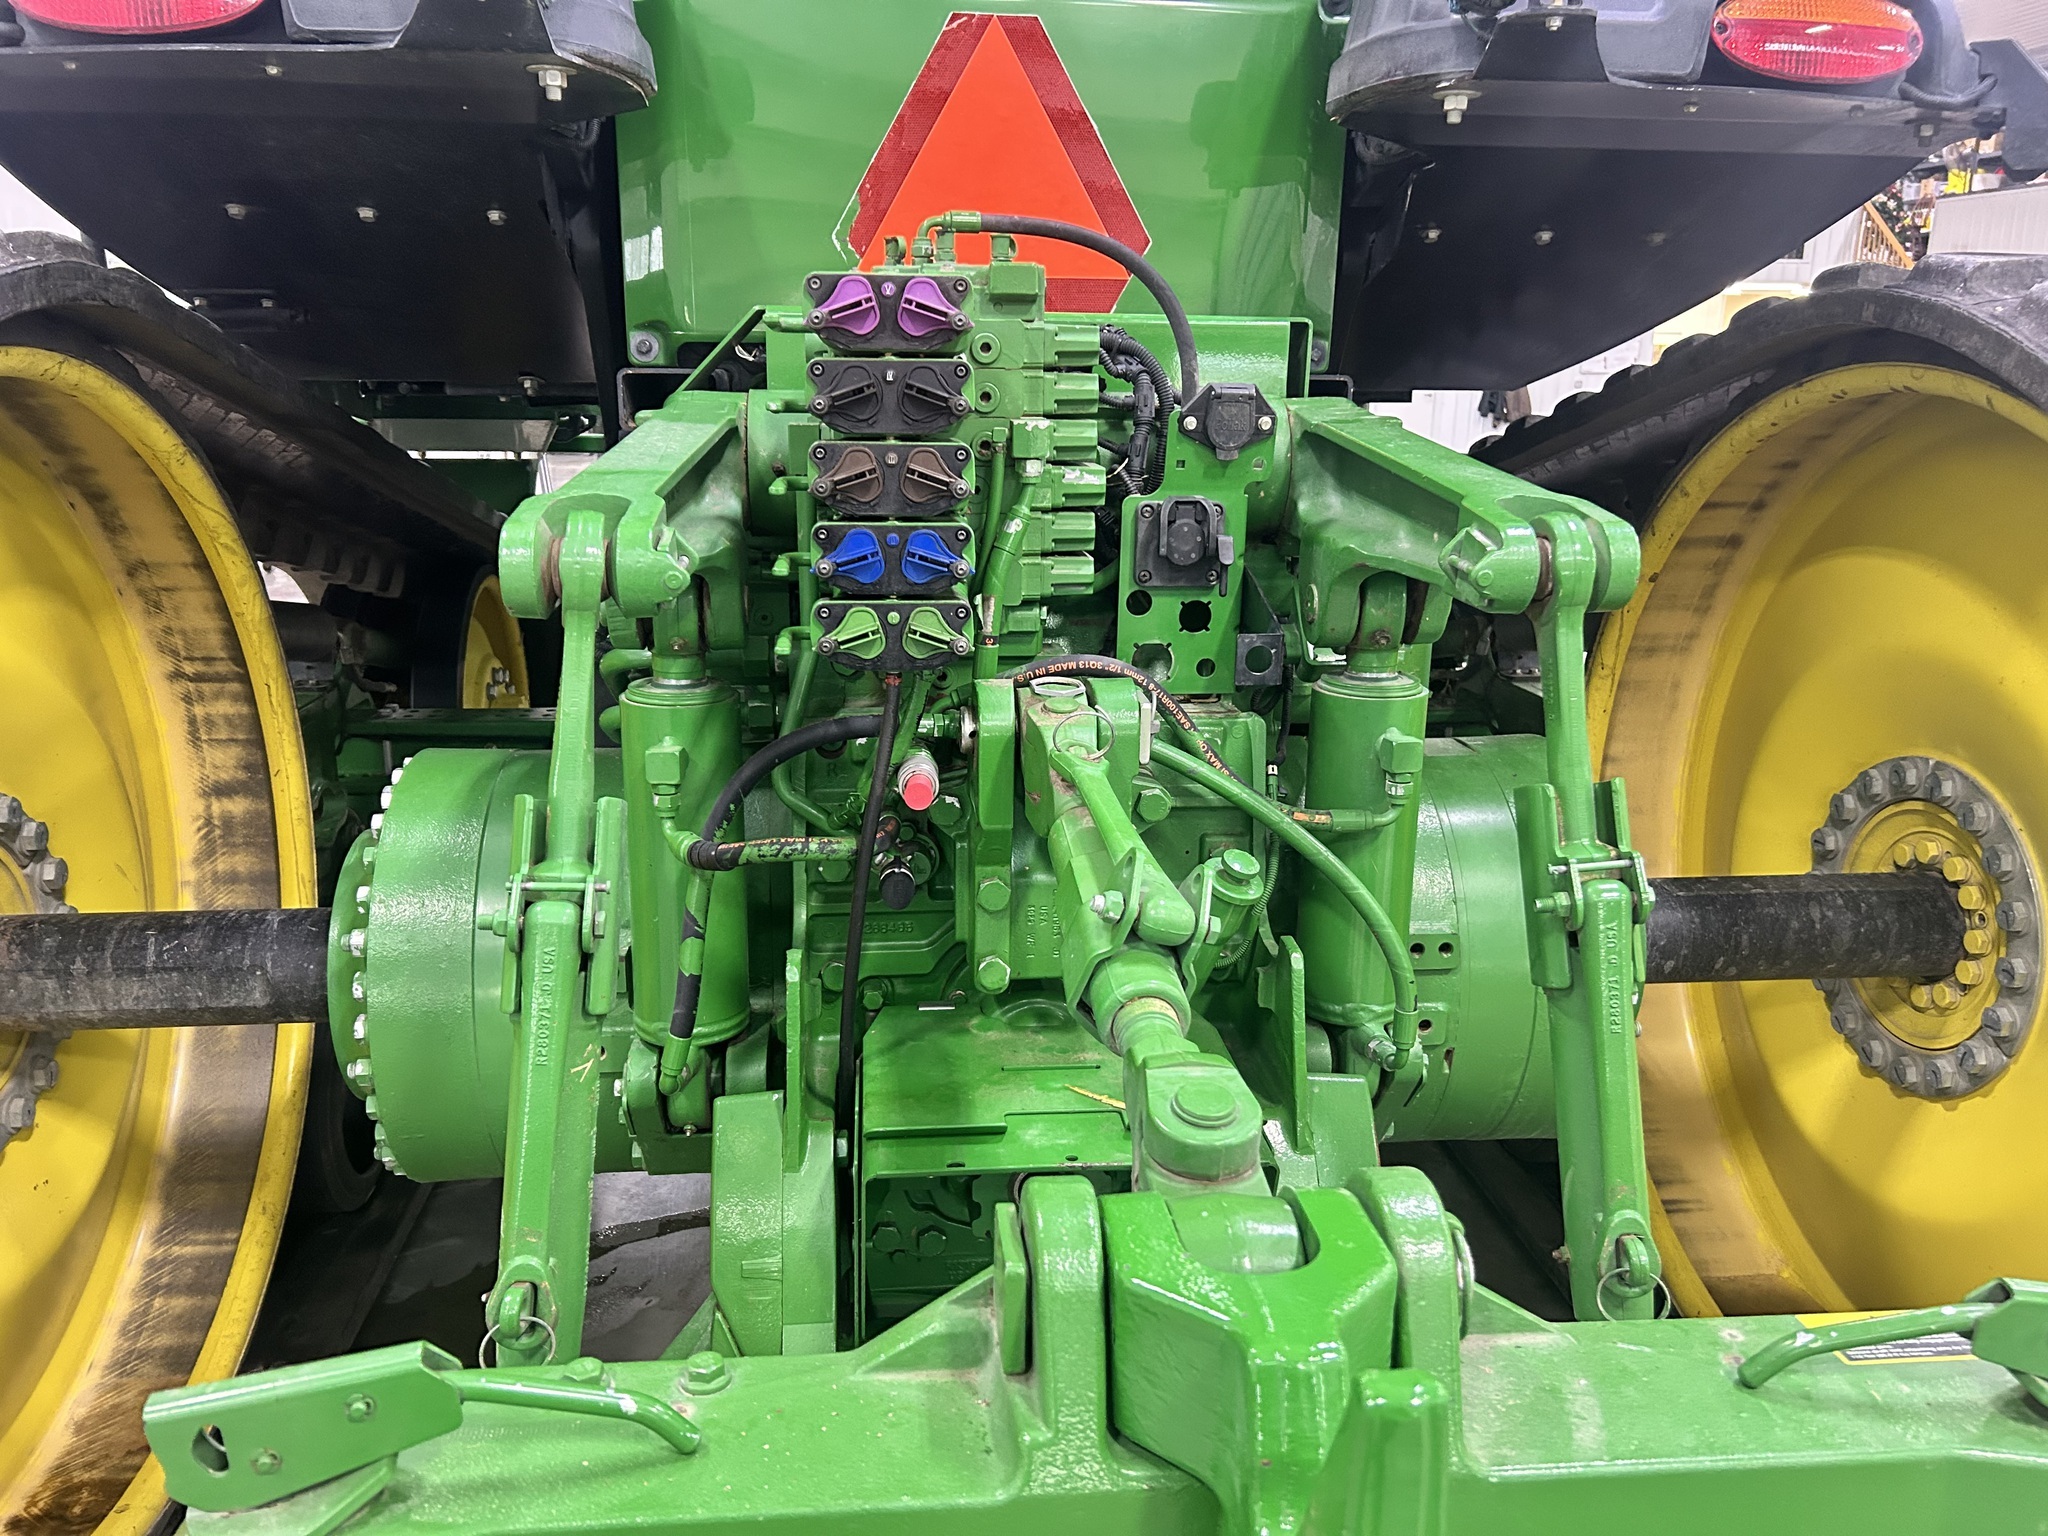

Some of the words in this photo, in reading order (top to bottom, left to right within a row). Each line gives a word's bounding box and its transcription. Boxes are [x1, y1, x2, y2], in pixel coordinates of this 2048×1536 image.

[1035, 667, 1046, 677] IN
[1047, 661, 1077, 674] MADE
[1105, 663, 1122, 673] 1/2"
[1124, 669, 1148, 687] 12mm
[1148, 682, 1191, 730] SAE100R17-8
[1205, 750, 1223, 769] MAX
[1039, 905, 1049, 926] USA
[1605, 920, 1618, 949] USA
[542, 946, 557, 975] USA
